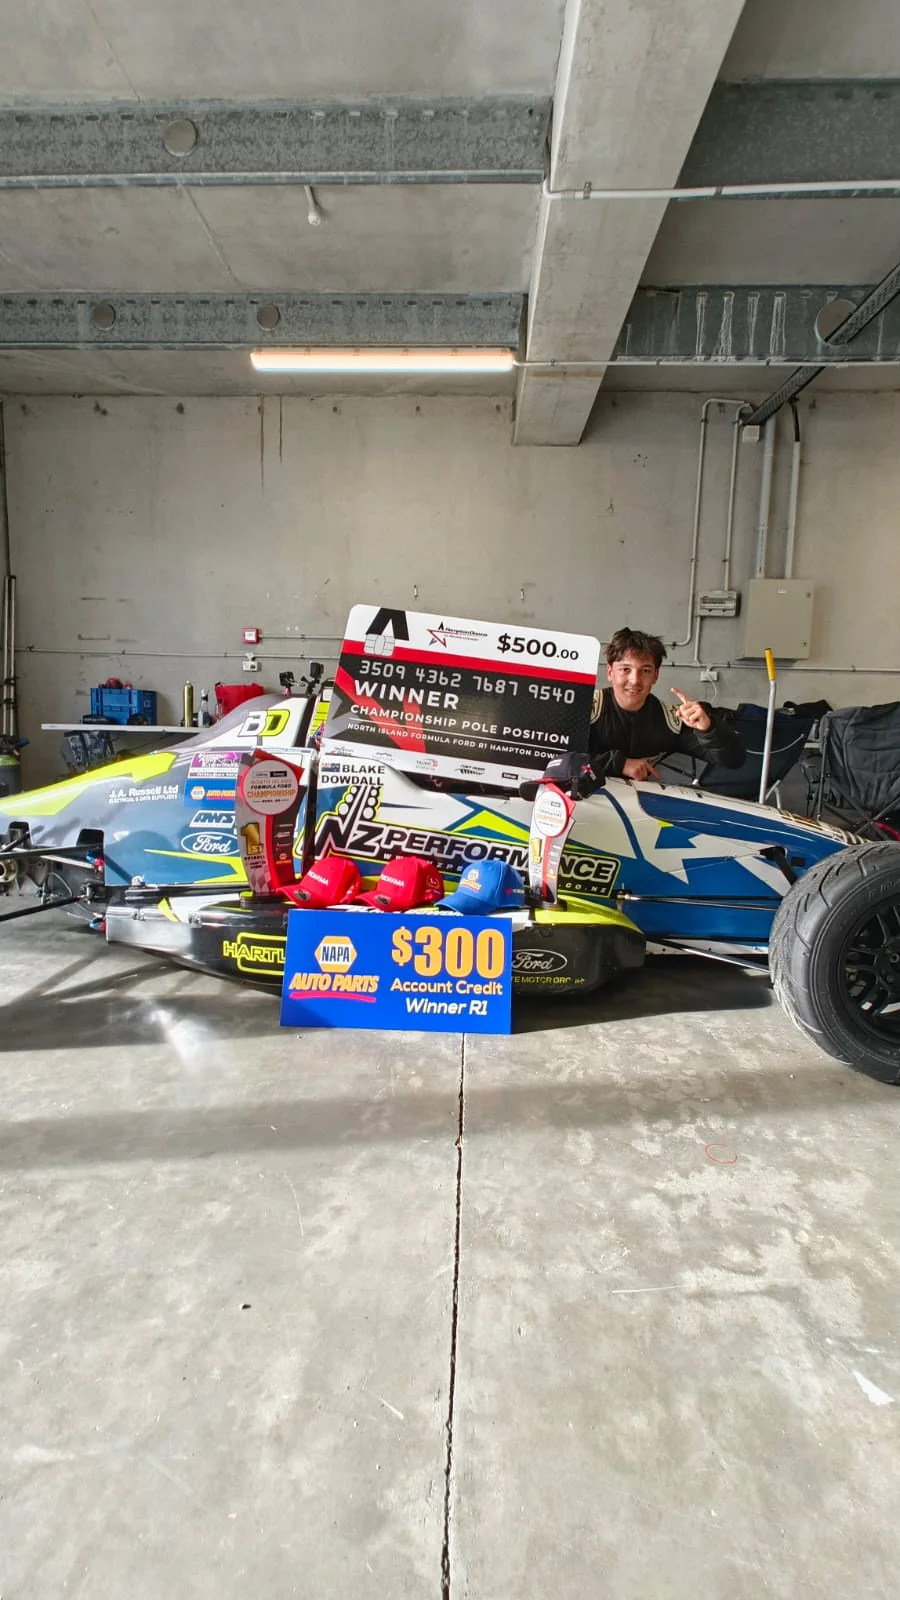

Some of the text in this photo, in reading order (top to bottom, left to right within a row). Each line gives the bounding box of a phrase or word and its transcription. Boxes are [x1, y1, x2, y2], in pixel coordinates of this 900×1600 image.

[496, 632, 579, 661] $500.00
[358, 659, 575, 705] 3509 4362 7687 9540
[353, 679, 460, 710] WINNER
[350, 703, 570, 746] CHAMPIONSHIP POLE POSITION
[347, 722, 376, 735] NORTH
[378, 725, 409, 739] ISLAND
[410, 730, 451, 744] FORMULA
[452, 736, 477, 749] FORD
[478, 741, 488, 751] R1
[489, 743, 533, 757] HAMPTON
[341, 763, 386, 775] BLAKE
[320, 774, 385, 787] DOWDALL
[109, 784, 179, 799] J.A. Russell Ltd
[192, 834, 232, 852] Ford
[321, 945, 350, 962] NAPA
[391, 926, 505, 979] $300
[512, 951, 554, 970] Ford
[288, 972, 380, 993] AUTO PARTS
[390, 977, 503, 995] Account Credit
[405, 997, 488, 1016] Winner R1
